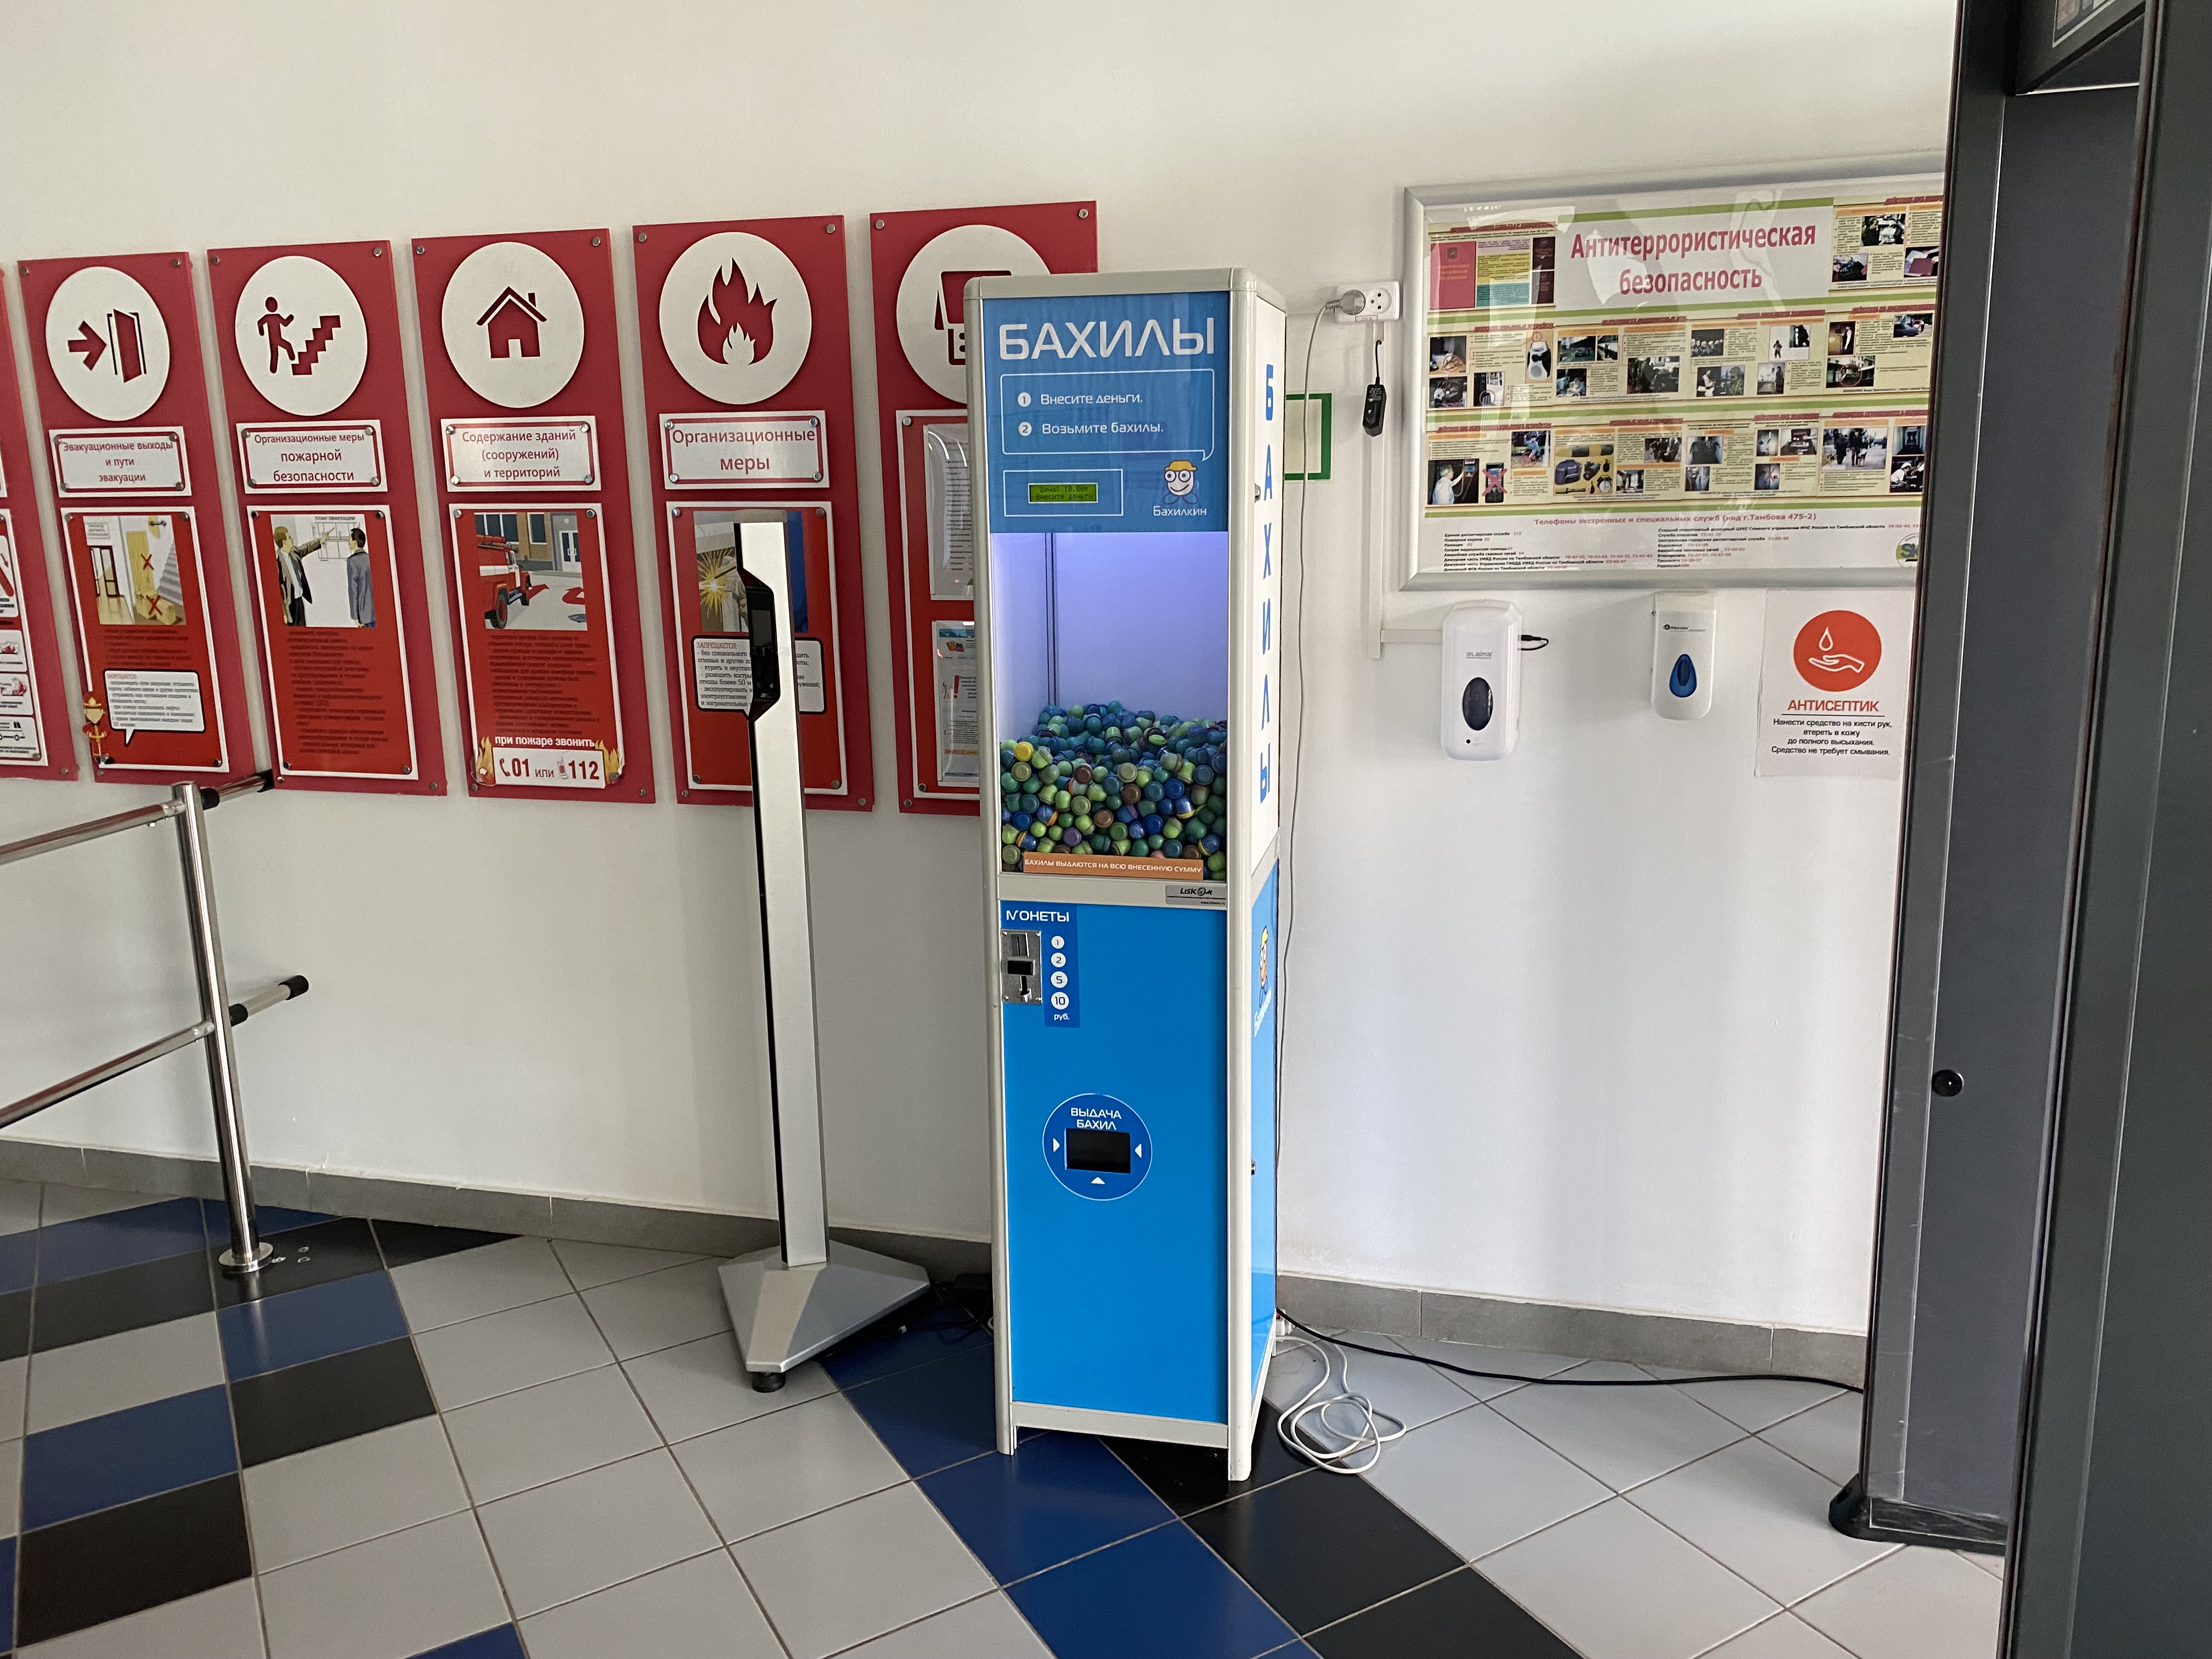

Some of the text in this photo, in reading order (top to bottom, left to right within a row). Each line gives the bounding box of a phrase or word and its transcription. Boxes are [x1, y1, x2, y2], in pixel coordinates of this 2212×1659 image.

[1571, 225, 1816, 261] Антитеррористическая
[1620, 268, 1762, 295] безопасность
[1000, 317, 1215, 360] БАХИЛЫ
[1041, 393, 1092, 405] Внесите
[1096, 393, 1143, 405] деньги.
[1042, 423, 1107, 435] Возьмите
[1111, 421, 1164, 434] бахилы.
[255, 434, 364, 445] Организационные меры
[462, 429, 576, 444] Содержание зданий
[673, 430, 815, 447] Организационные
[64, 442, 173, 453] Эвакуационные выходы
[281, 449, 342, 464] пожарной
[482, 448, 559, 462] (сооружений)
[114, 459, 134, 468] пути
[720, 458, 770, 475] меры
[99, 474, 145, 484] эвакуации
[273, 470, 354, 482] безопасности
[494, 466, 560, 480] территорий
[1153, 506, 1207, 517] Бахилкин
[1788, 700, 1879, 712] АНТИСЕПТИК
[495, 736, 595, 747] при пожаре звонить
[1820, 747, 1848, 755] требует
[511, 758, 529, 777] 01
[568, 760, 600, 780] 112
[1128, 864, 1173, 872] ВНЕСЕННУЮ
[1053, 1012, 1070, 1021] руб.
[1071, 1107, 1122, 1119] ВЫДАЧА
[1076, 1119, 1116, 1130] БАХИЛ
